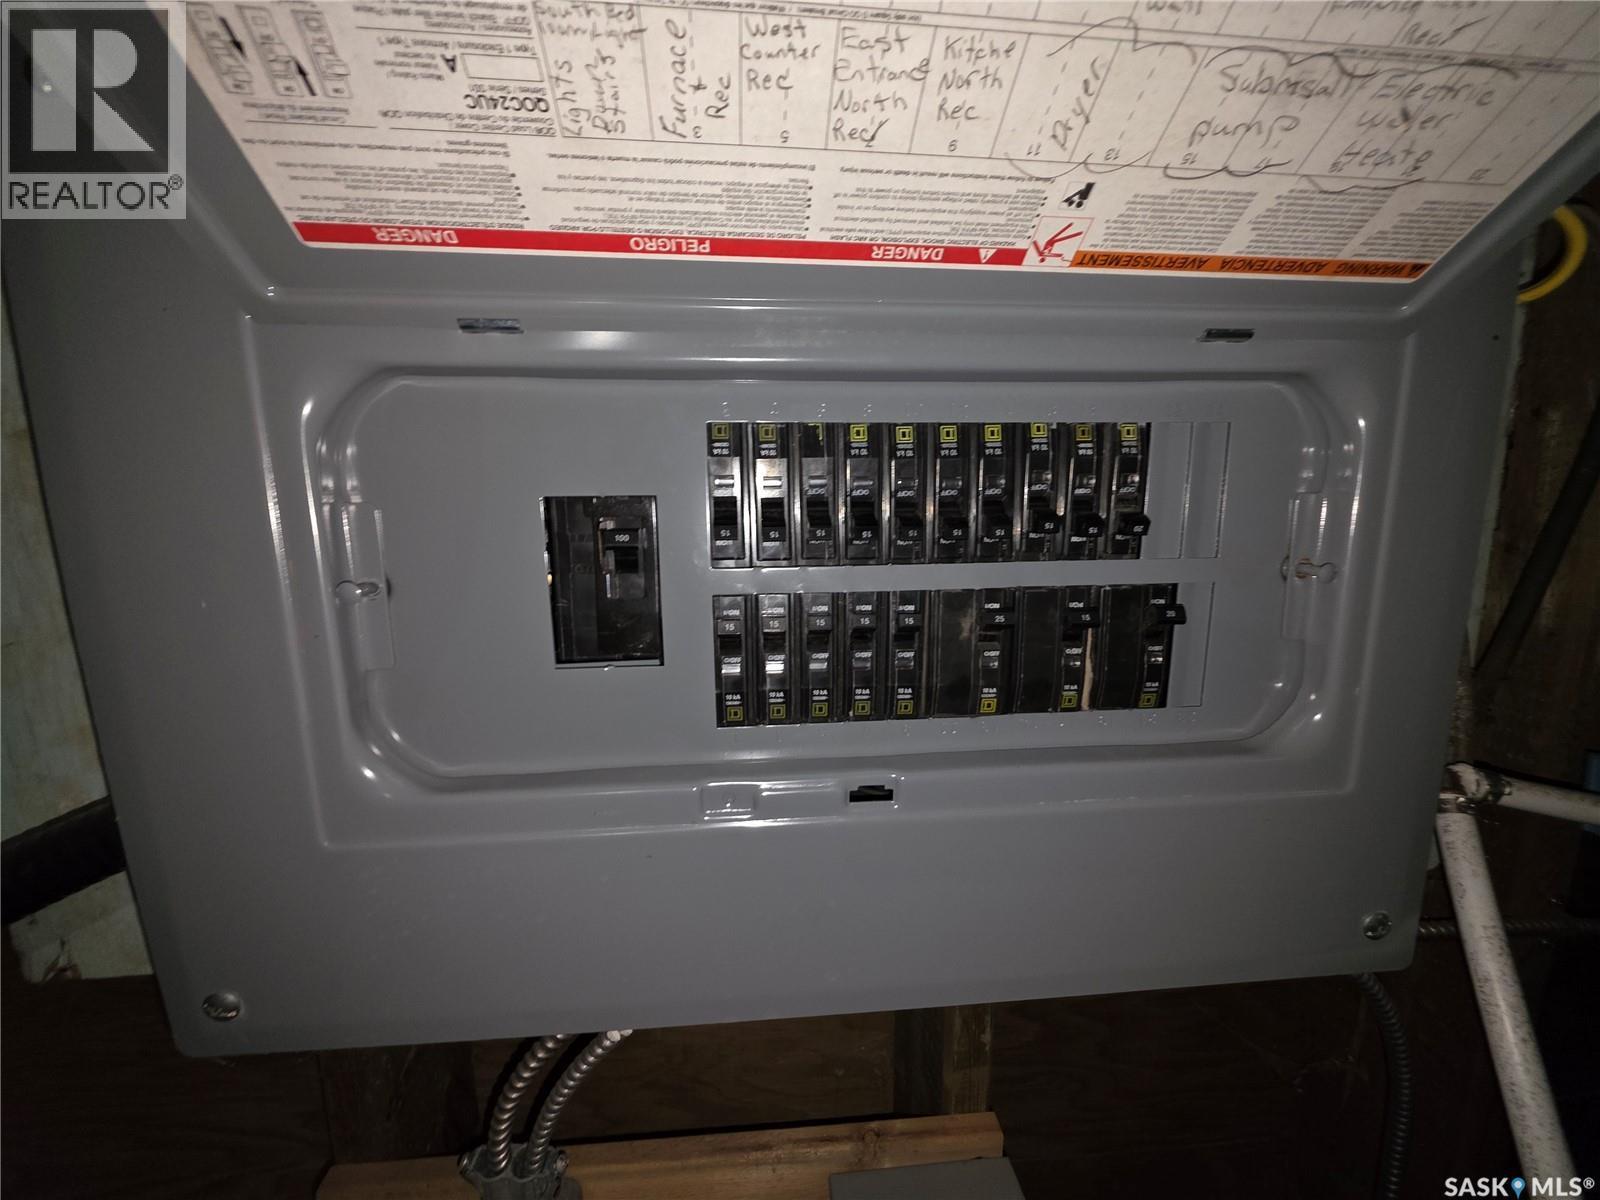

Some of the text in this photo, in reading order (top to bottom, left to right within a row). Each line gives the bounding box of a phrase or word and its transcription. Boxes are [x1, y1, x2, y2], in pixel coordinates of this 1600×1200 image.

[440, 53, 457, 74] A
[463, 94, 551, 113] QOC24UC
[372, 226, 458, 246] DANGER
[629, 236, 712, 254] PELIGRO
[871, 245, 945, 262] DANGER
[1074, 253, 1211, 270] AVERTISSEMENT
[1219, 256, 1329, 274] ADVERTENCIA
[1333, 262, 1407, 278] WARNING
[952, 528, 962, 537] 15
[725, 623, 735, 631] 15
[769, 620, 779, 628] 15
[816, 619, 826, 627] 15
[860, 617, 870, 625] 15
[904, 617, 914, 625] 15
[994, 615, 1005, 623] 25
